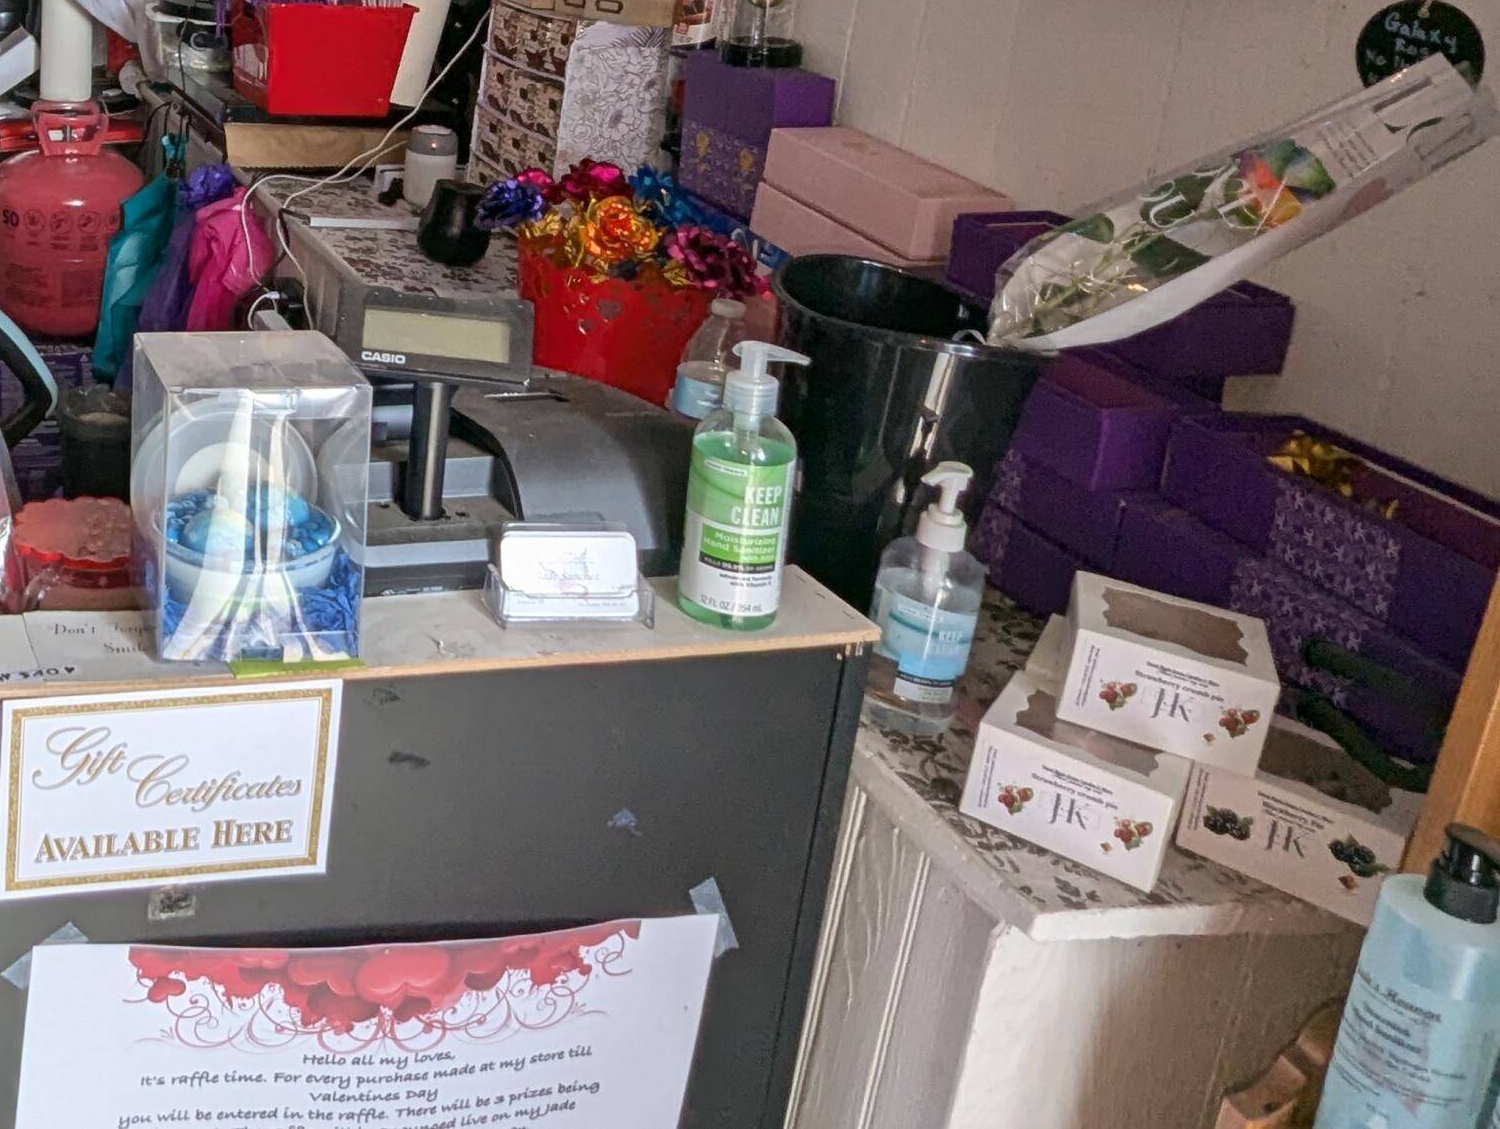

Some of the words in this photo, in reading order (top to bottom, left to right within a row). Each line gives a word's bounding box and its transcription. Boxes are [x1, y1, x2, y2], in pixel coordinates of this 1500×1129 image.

[1385, 11, 1458, 54] Galaxy
[361, 351, 406, 364] CASIO
[744, 486, 782, 505] KEEP
[731, 506, 780, 526] CLEAN
[715, 531, 777, 546] Moisturizing
[709, 596, 719, 608] FL
[720, 600, 730, 611] OZ
[31, 726, 128, 790] Gift
[126, 753, 303, 813] Certificates
[34, 826, 201, 864] AVAILABLE
[210, 819, 294, 849] HERE
[140, 1076, 166, 1086] It's
[171, 1071, 220, 1087] raffle
[224, 1070, 267, 1083] time.
[274, 1072, 301, 1083] For
[305, 1073, 350, 1089] every
[355, 1071, 429, 1088] purchase
[433, 1064, 476, 1079] made
[479, 1061, 496, 1073] at
[500, 1057, 526, 1072] my
[529, 1049, 565, 1064] store
[569, 1045, 593, 1058] till
[303, 1054, 346, 1066] Hello
[351, 1054, 374, 1066] all
[379, 1056, 408, 1070] my
[118, 1114, 152, 1129] you
[157, 1108, 190, 1122] will
[195, 1108, 212, 1120] be
[217, 1108, 278, 1120] entered
[283, 1106, 304, 1119] in
[308, 1109, 334, 1121] the
[338, 1107, 389, 1123] raffle.
[395, 1106, 437, 1118] There
[441, 1098, 471, 1113] will
[475, 1095, 491, 1108] be
[493, 1097, 505, 1105] 3
[509, 1086, 553, 1106] prizes
[558, 1080, 600, 1095] being
[309, 1089, 401, 1103] Valentines
[405, 1088, 438, 1103] Day
[461, 1113, 487, 1128] live
[491, 1113, 512, 1122] on
[515, 1106, 541, 1120] my
[540, 1100, 576, 1117] Jade
